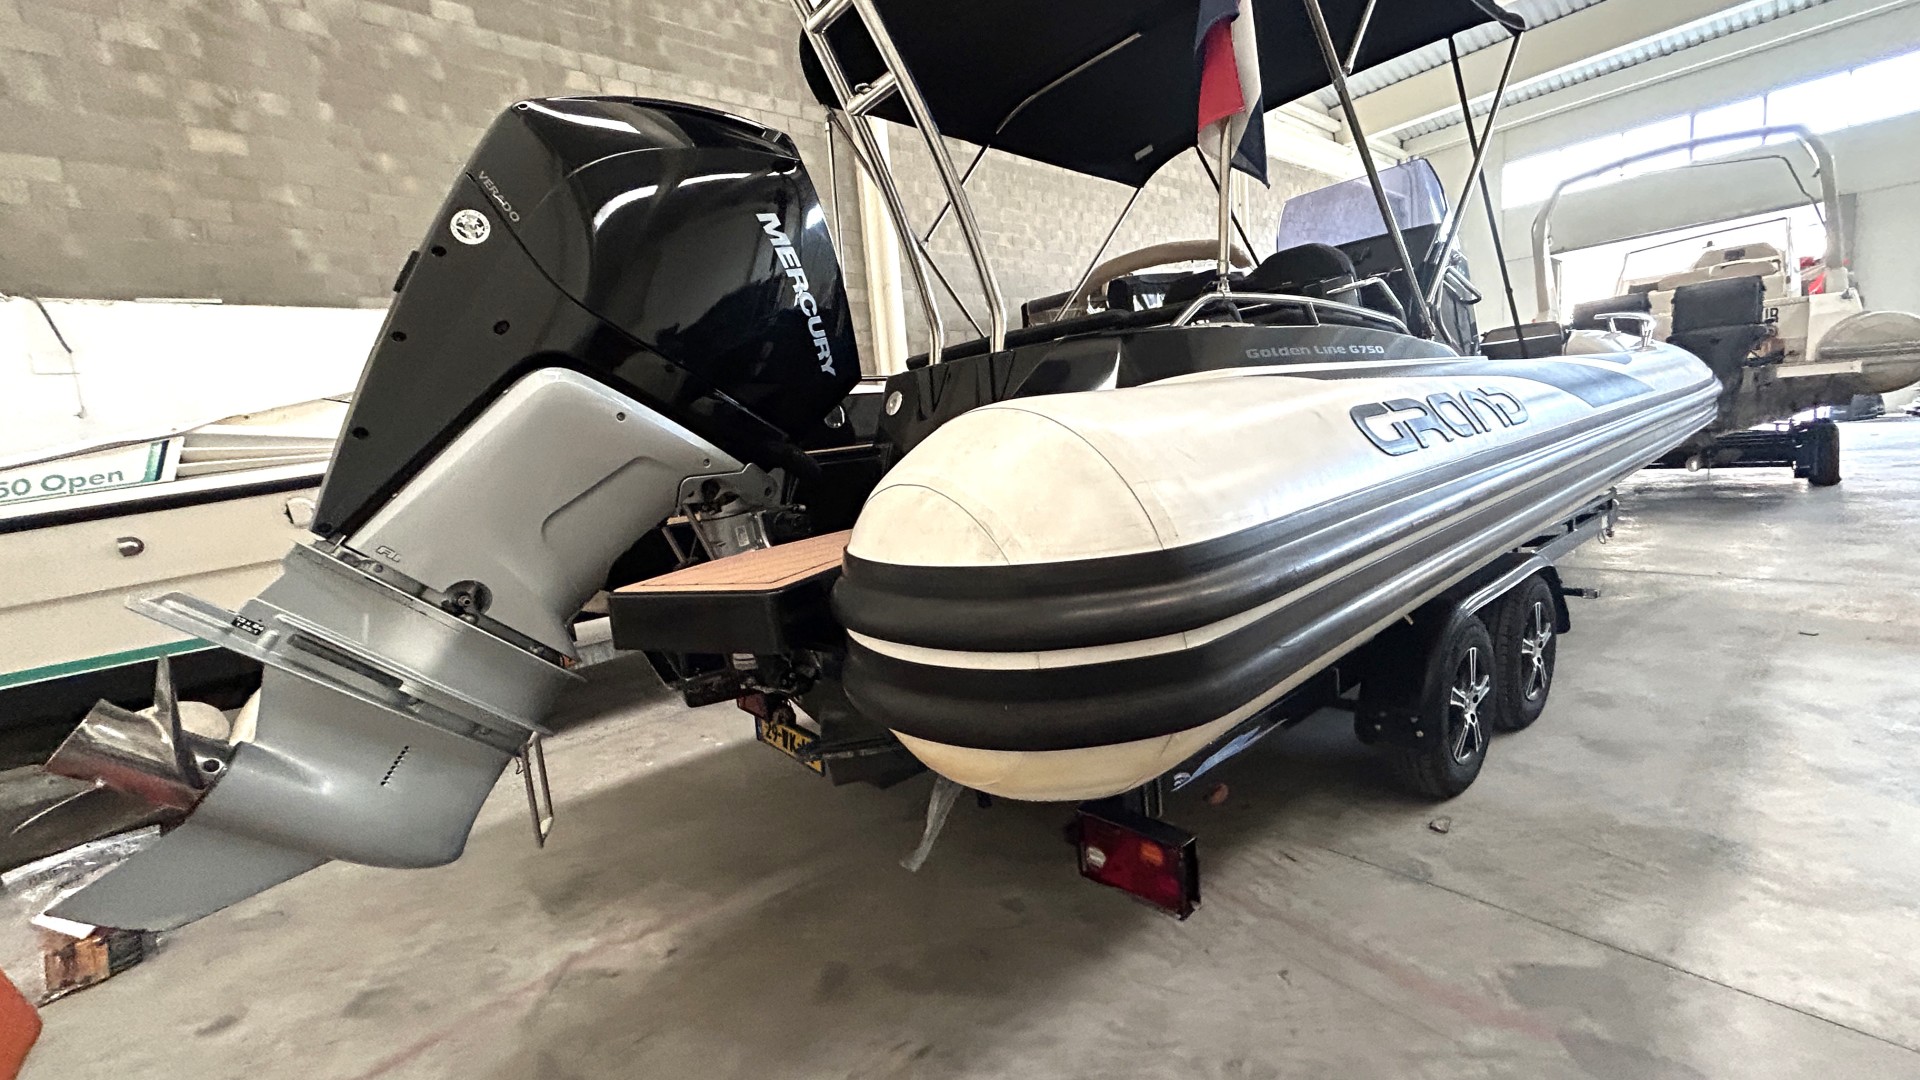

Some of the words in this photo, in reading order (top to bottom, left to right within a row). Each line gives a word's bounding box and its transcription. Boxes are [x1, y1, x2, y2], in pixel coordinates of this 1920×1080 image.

[478, 170, 520, 222] VERADO
[756, 212, 837, 377] MERCURY
[1245, 345, 1311, 359] Golden
[1313, 345, 1347, 355] Line
[1348, 345, 1385, 354] G750
[1349, 386, 1529, 457] GRAND
[40, 470, 125, 494] Open
